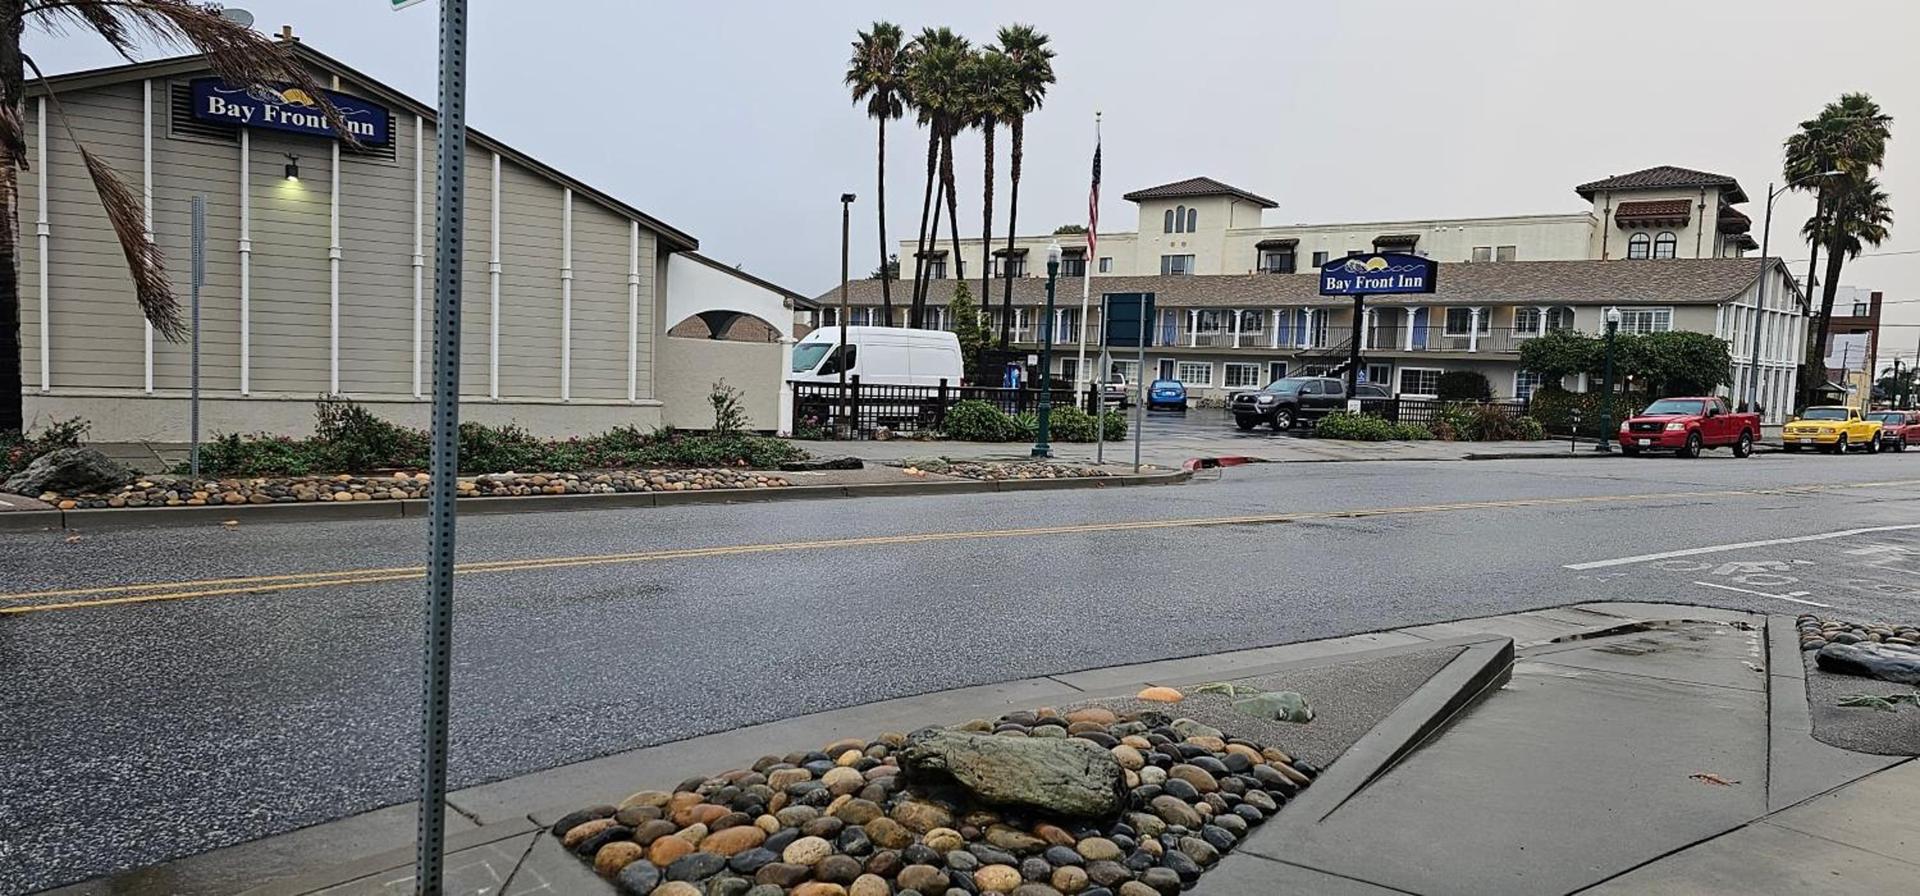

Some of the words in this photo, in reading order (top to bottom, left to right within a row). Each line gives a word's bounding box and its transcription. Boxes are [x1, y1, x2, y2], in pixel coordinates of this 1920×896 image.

[208, 96, 254, 123] Bay
[263, 104, 330, 130] Front
[1326, 277, 1351, 292] Bay
[1355, 276, 1394, 288] Front
[1397, 274, 1423, 287] Inn
